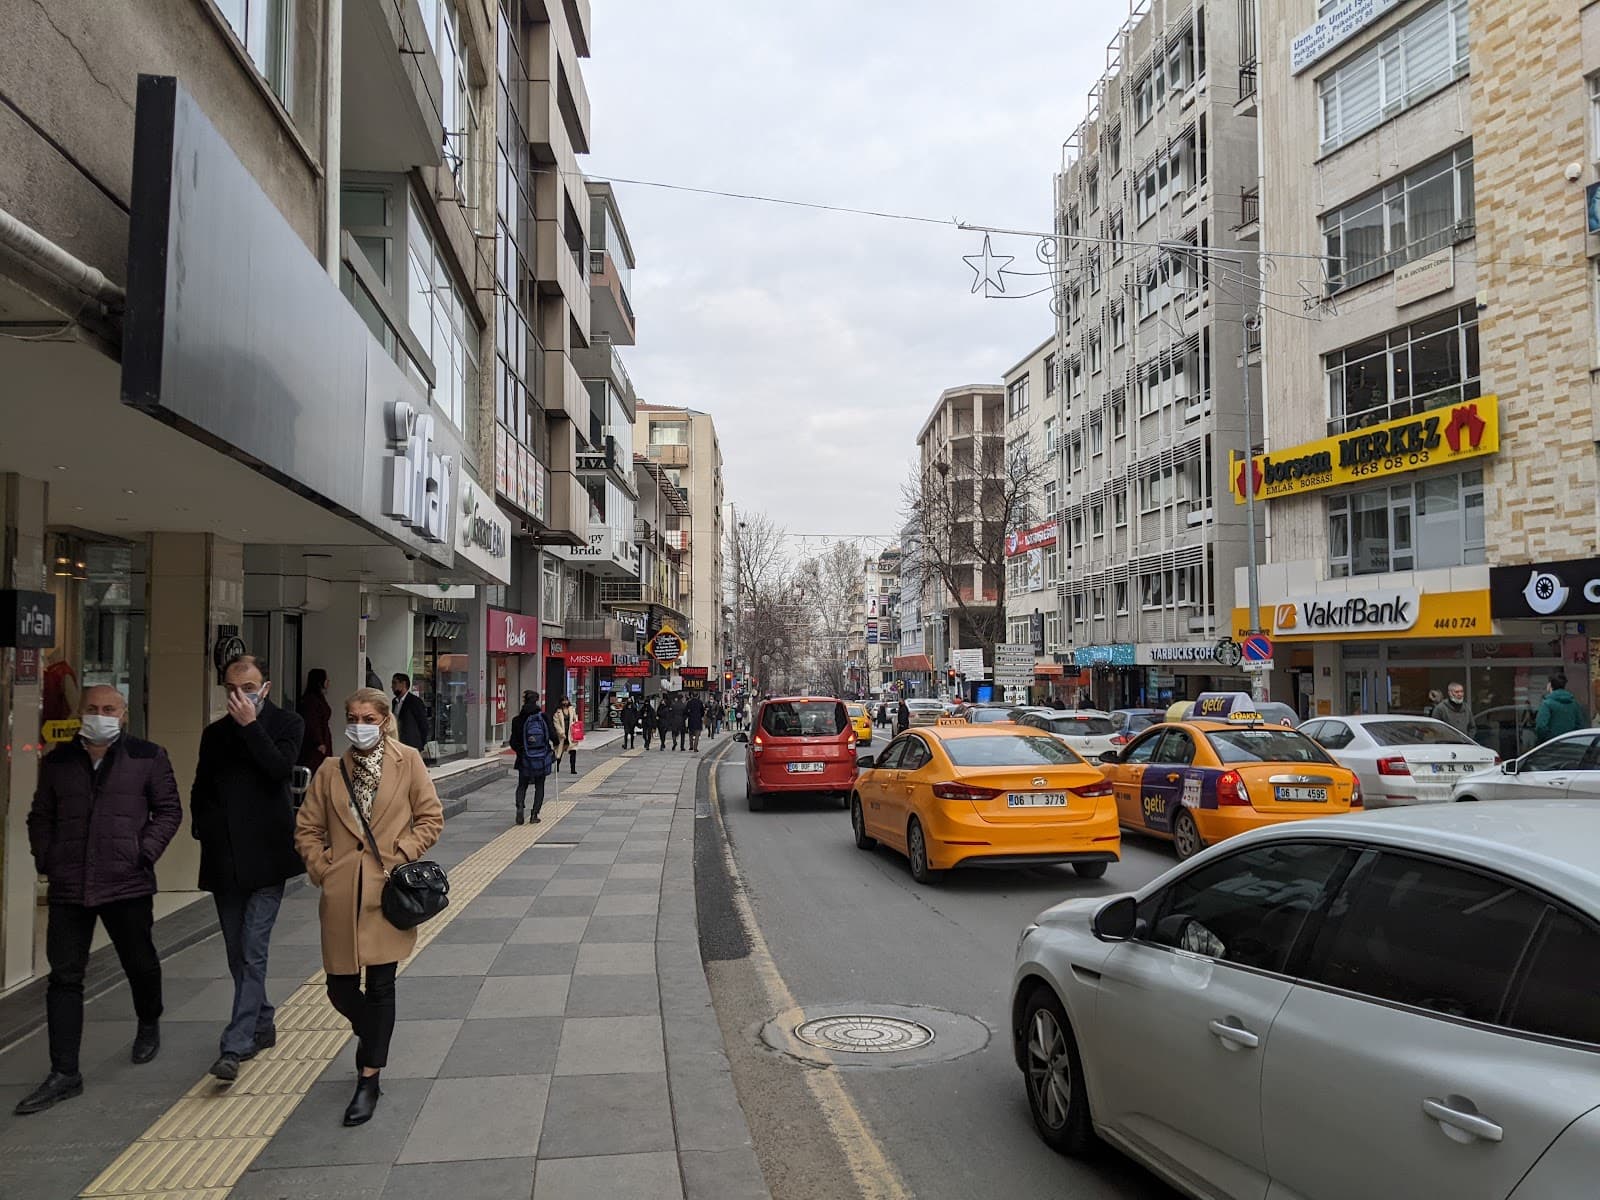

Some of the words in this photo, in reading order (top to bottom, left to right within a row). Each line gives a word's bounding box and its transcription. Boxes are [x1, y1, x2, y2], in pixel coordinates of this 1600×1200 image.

[1294, 34, 1313, 50] Uzm.
[1316, 23, 1327, 35] Dr.
[1329, 3, 1352, 25] Umut
[1338, 416, 1442, 467] MERKEZ
[1351, 462, 1378, 477] 468
[1384, 457, 1403, 470] 08
[1410, 451, 1430, 465] 03
[1266, 482, 1294, 495] EMLAK
[1300, 474, 1333, 488] BORSASI
[570, 546, 602, 555] Bride
[1303, 596, 1408, 627] VakıfBank
[1434, 619, 1450, 629] 444
[1452, 618, 1458, 629] 0
[1460, 617, 1476, 628] 724
[570, 655, 604, 663] MISSHA
[1150, 647, 1193, 660] STARBUCKS
[1201, 696, 1226, 715] getir
[1014, 795, 1025, 806] 06
[1030, 795, 1035, 805] T
[1045, 794, 1065, 805] 3778
[1280, 788, 1290, 797] 06
[1295, 788, 1300, 798] T
[1308, 788, 1325, 798] 4595
[1143, 794, 1166, 816] getir
